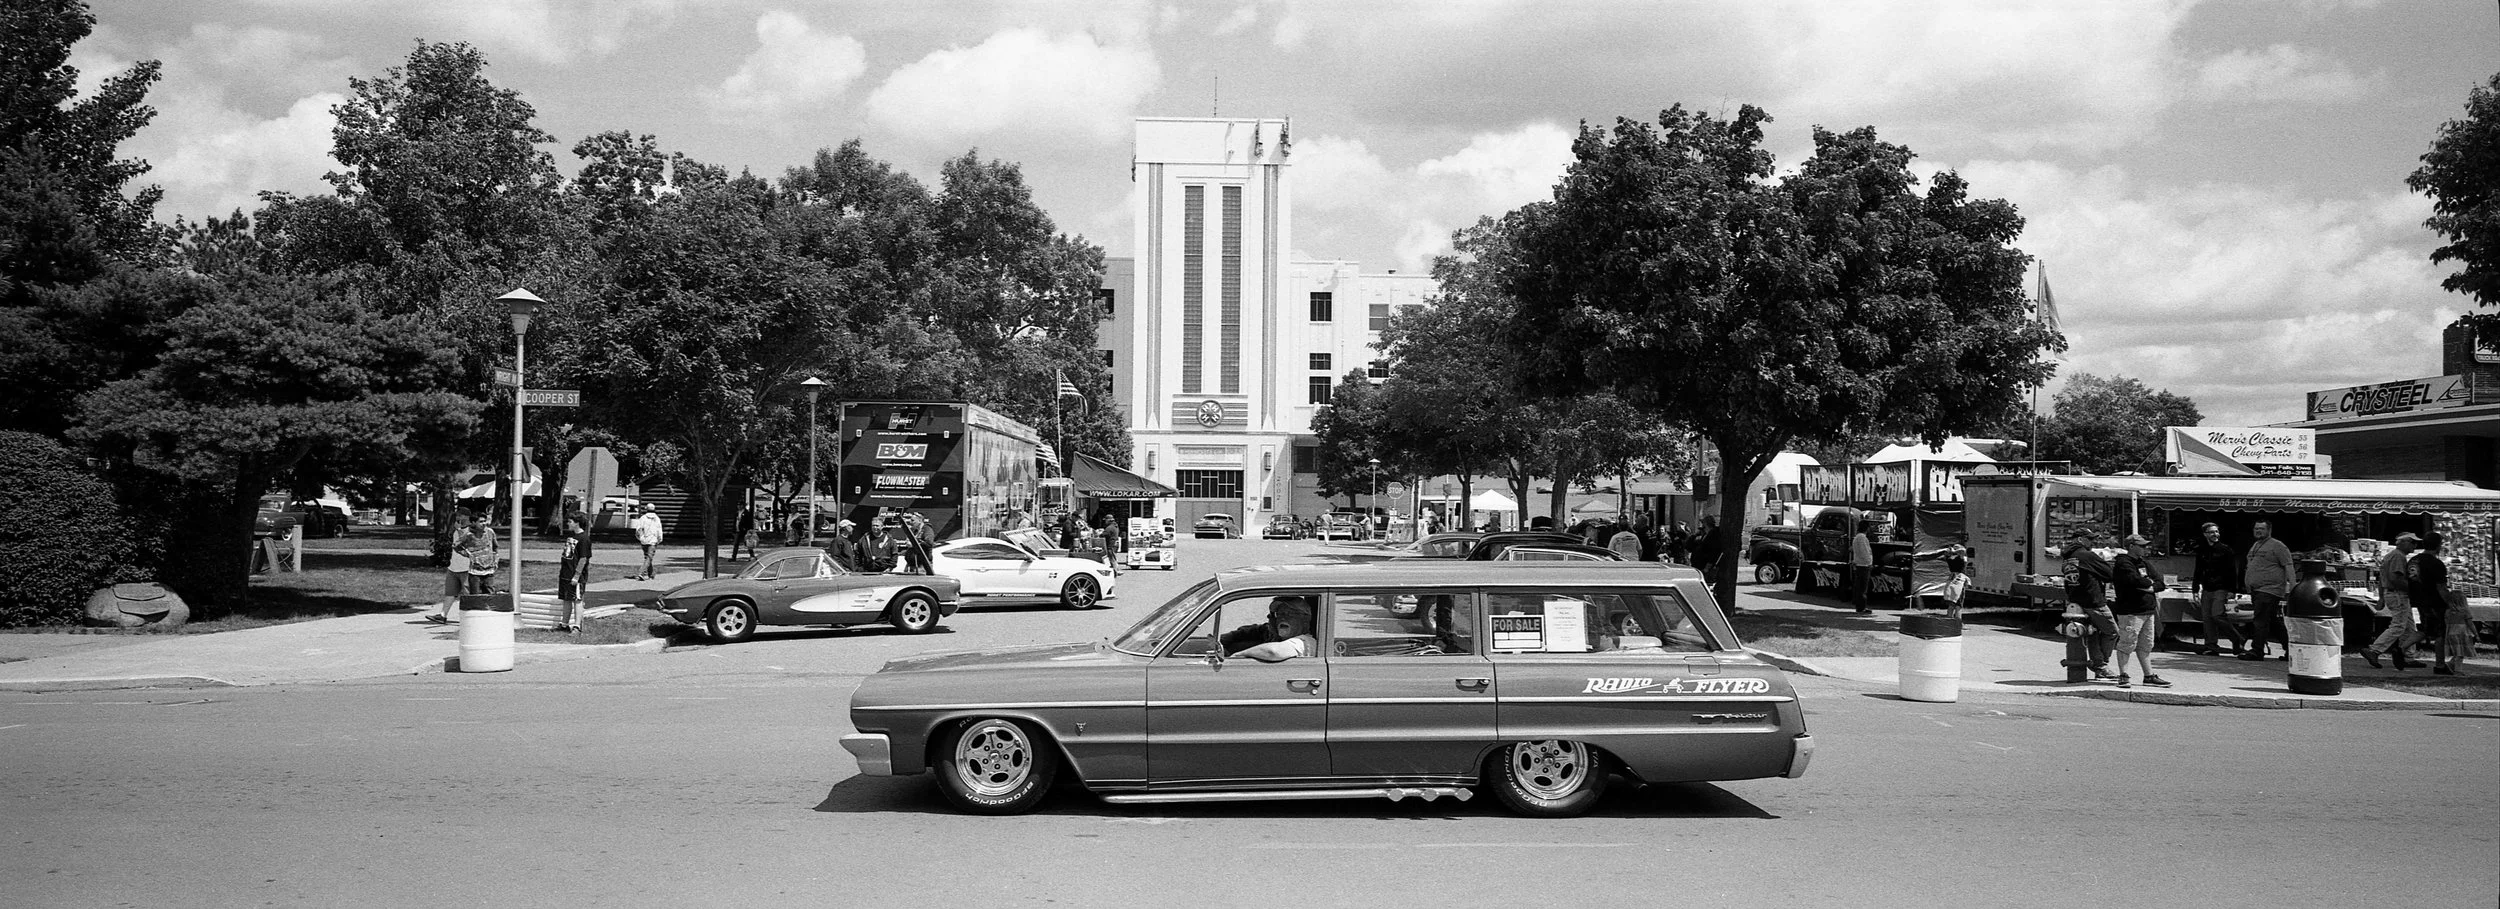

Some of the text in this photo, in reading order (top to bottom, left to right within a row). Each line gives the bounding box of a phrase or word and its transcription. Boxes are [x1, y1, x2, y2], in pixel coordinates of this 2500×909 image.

[525, 393, 579, 404] COOPER ST
[2341, 384, 2432, 412] CRYSTEEL
[2208, 432, 2291, 445] Merv's Classic
[878, 445, 926, 457] B&M
[2231, 446, 2291, 459] Chevy Parts
[875, 476, 926, 488] FLOWMASTER
[1855, 465, 1907, 501] RAT ROD
[1929, 464, 1970, 501] RA
[2220, 499, 2230, 507] 55
[2237, 499, 2248, 507] 56
[2253, 499, 2264, 507] 57
[2328, 501, 2368, 509] Classic
[2373, 501, 2405, 510] Chevy
[2409, 502, 2440, 510] Parts
[2464, 502, 2475, 510] 55
[2481, 502, 2493, 510] 56
[1493, 619, 1540, 632] FOR SALE
[1582, 678, 1770, 693] RADIO FLYER
